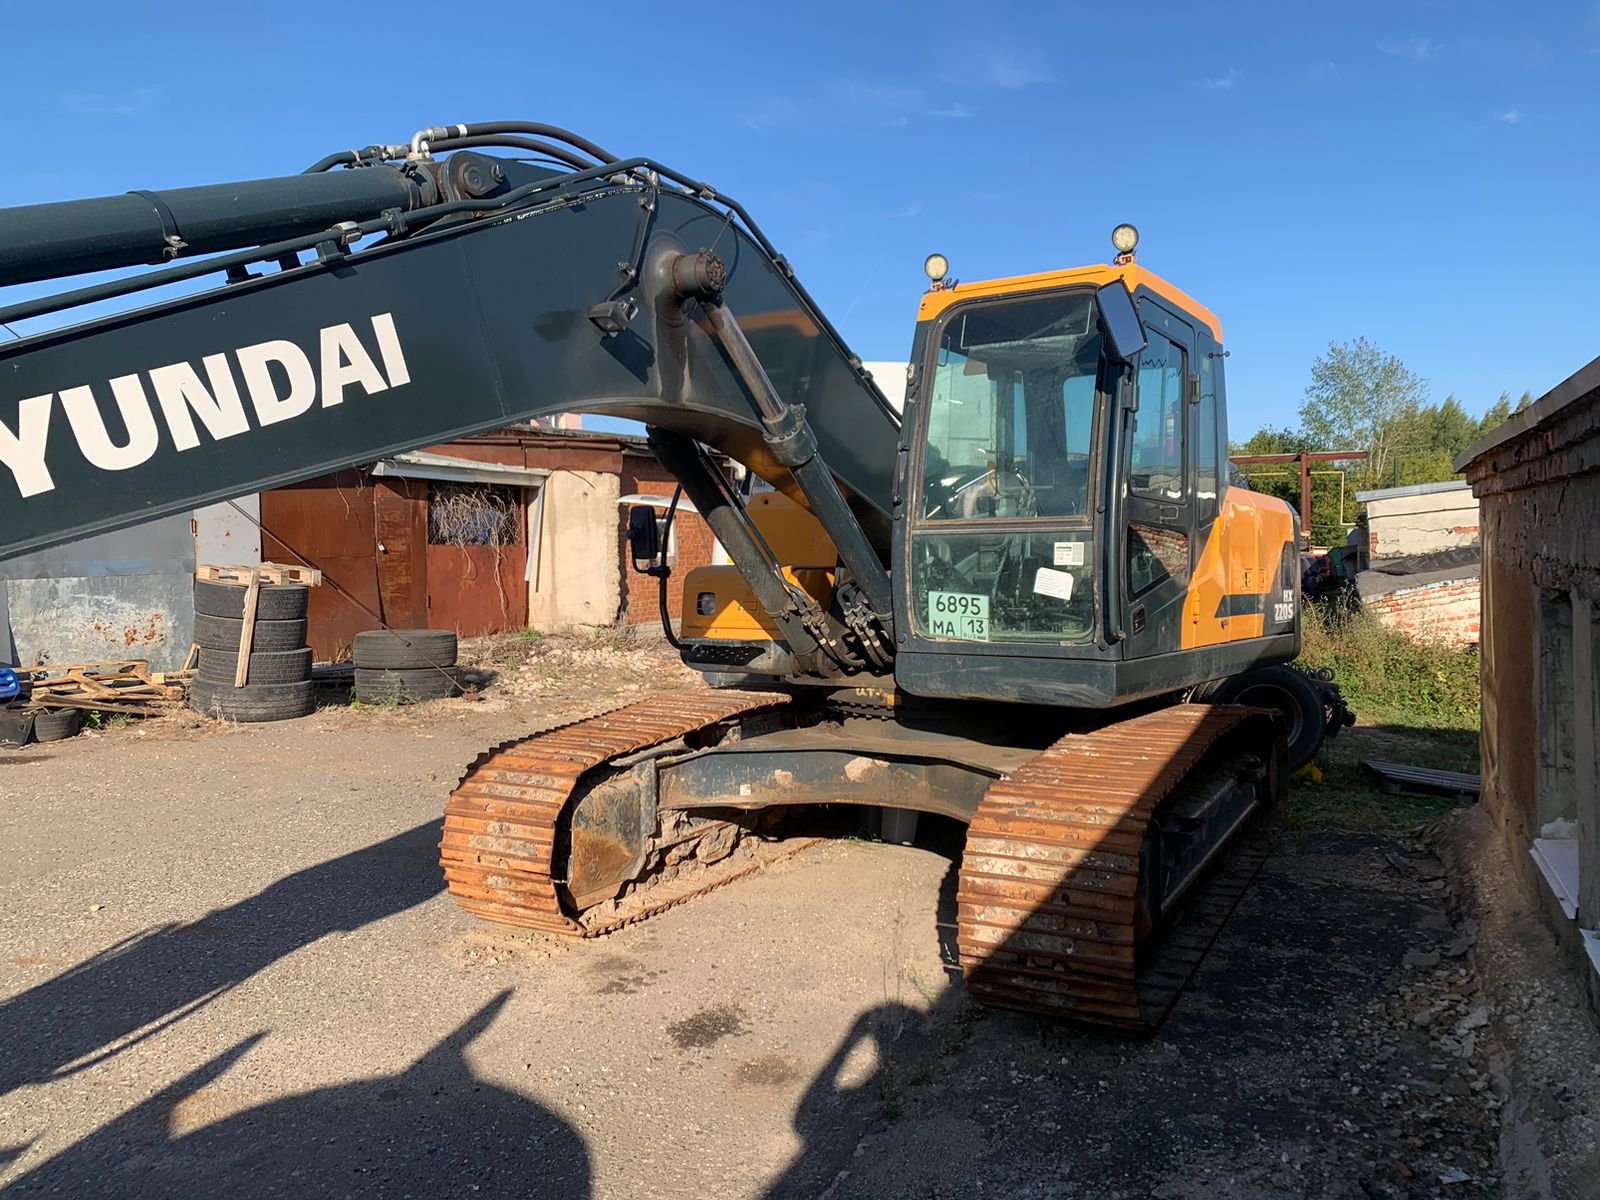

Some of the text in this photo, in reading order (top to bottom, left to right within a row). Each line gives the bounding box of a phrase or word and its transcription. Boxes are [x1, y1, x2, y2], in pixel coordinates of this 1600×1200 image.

[0, 312, 411, 498] YUNDAI
[1283, 589, 1293, 602] HX
[936, 594, 981, 616] 6895
[1274, 603, 1294, 621] 220S
[967, 619, 984, 634] 13
